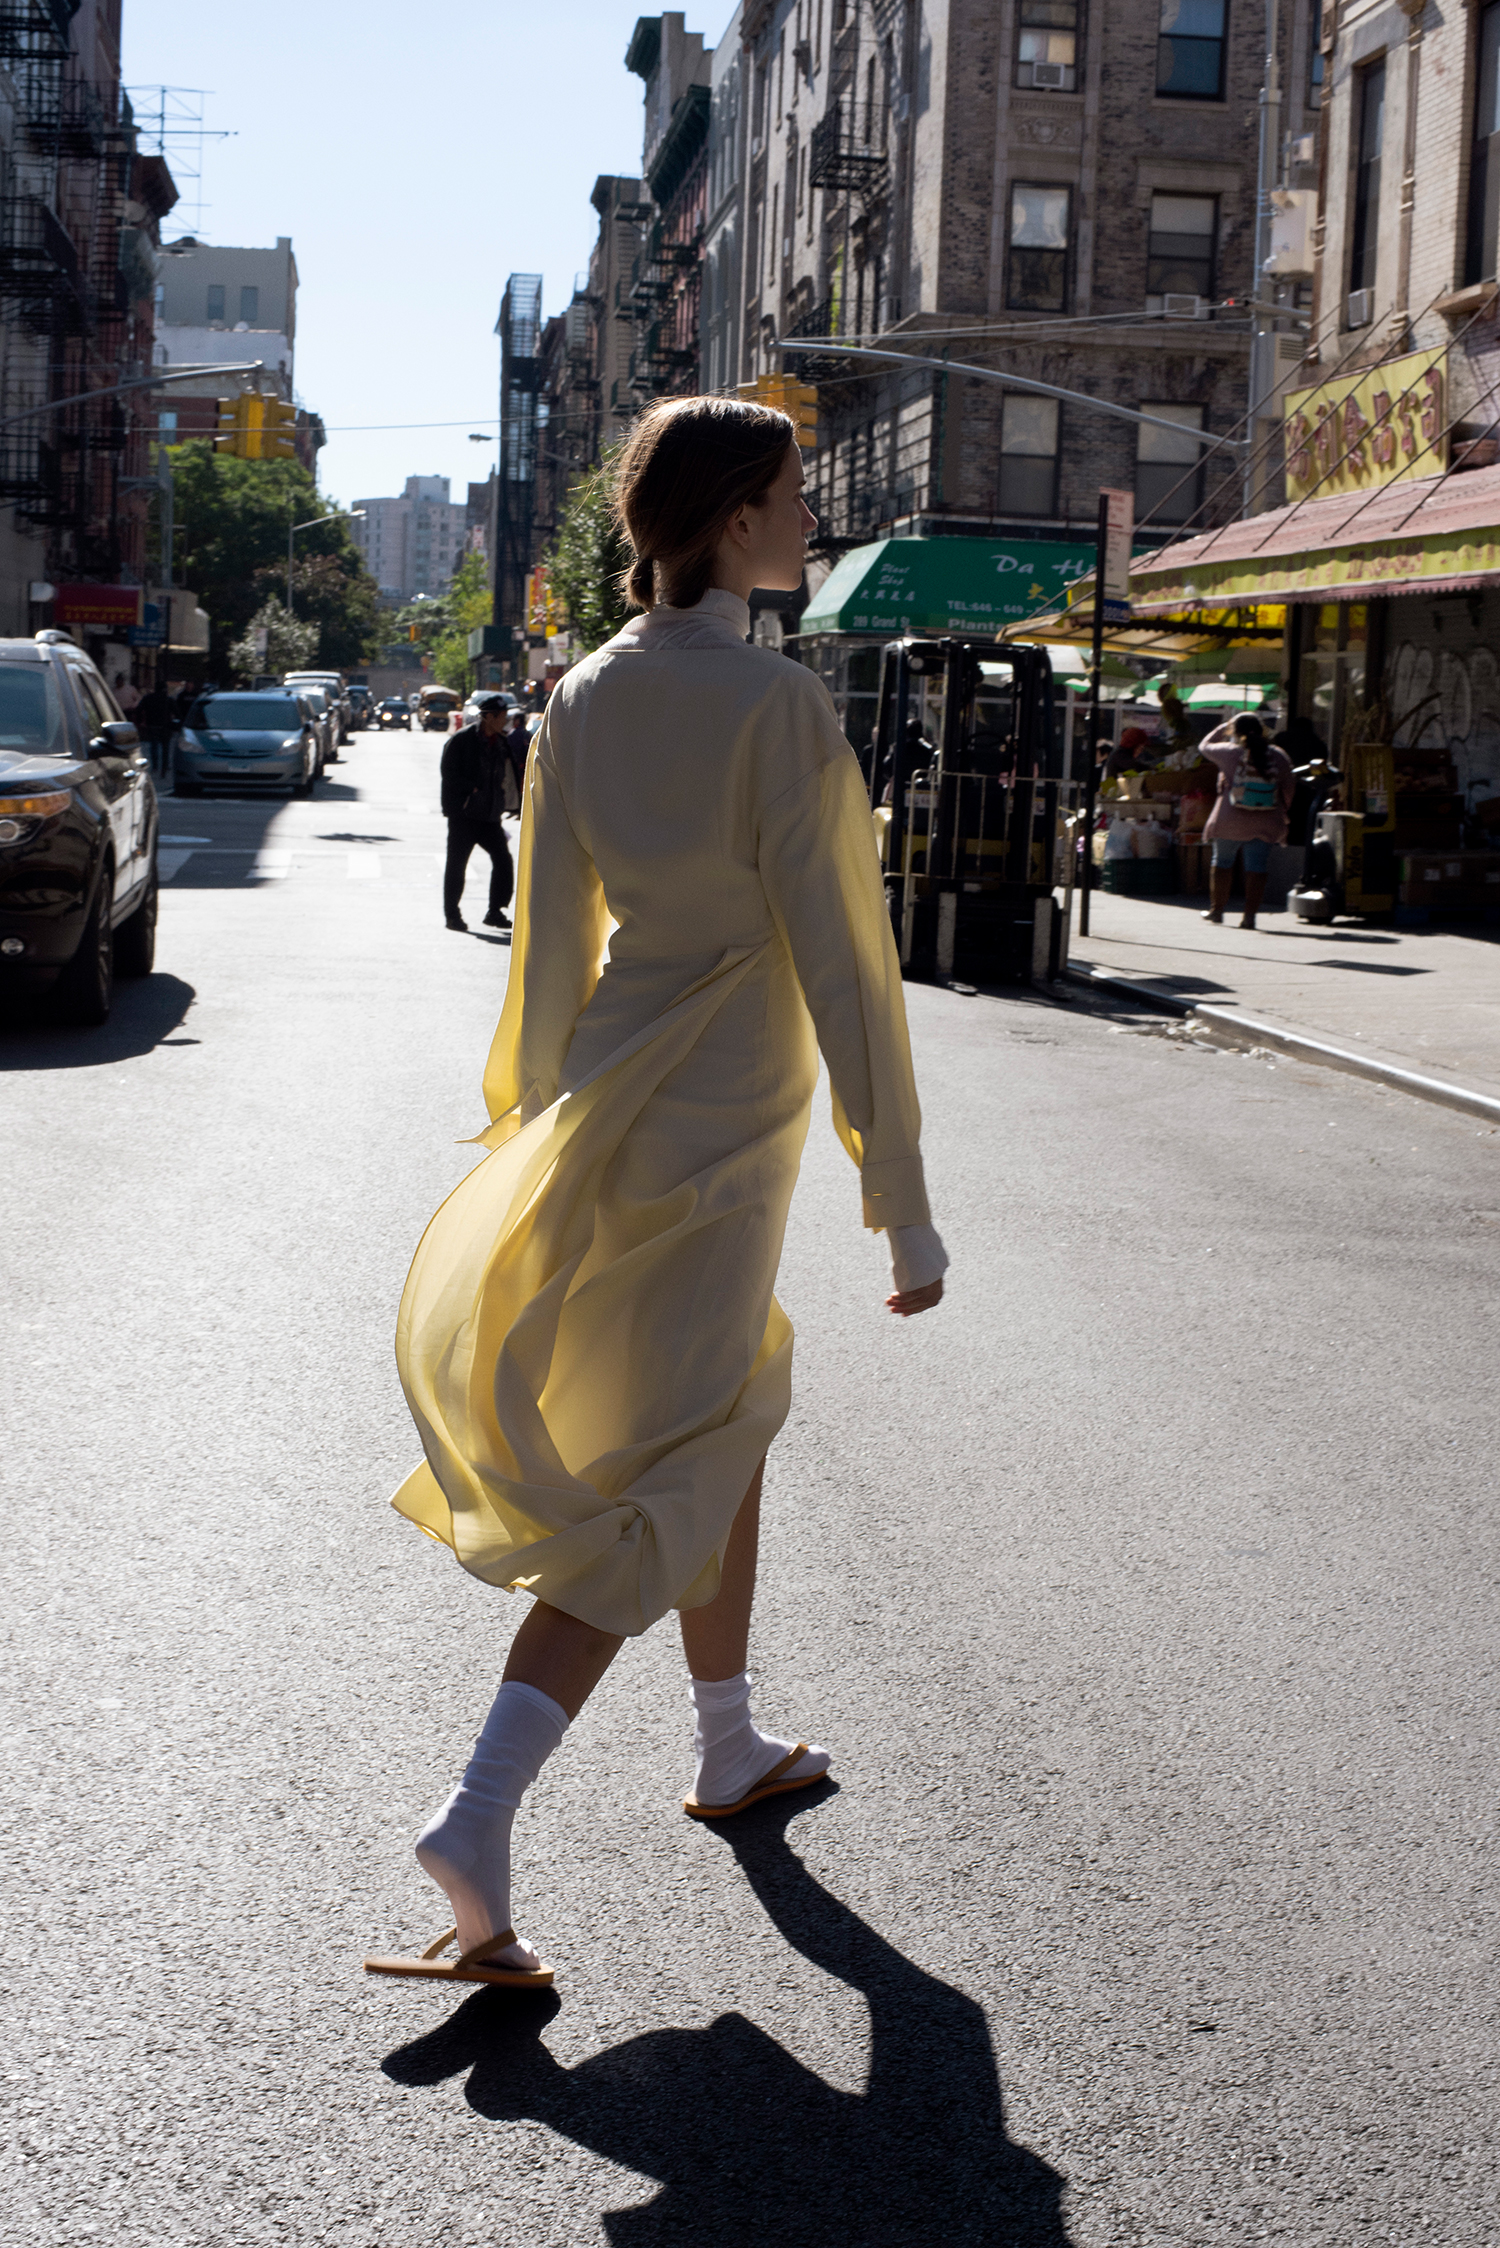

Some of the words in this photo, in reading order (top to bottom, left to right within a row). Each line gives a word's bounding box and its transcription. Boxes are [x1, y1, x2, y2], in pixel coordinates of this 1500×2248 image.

[880, 563, 910, 574] Plant
[990, 554, 1034, 574] Da
[1051, 559, 1096, 576] H
[878, 575, 905, 586] Shop
[871, 615, 897, 628] Grand
